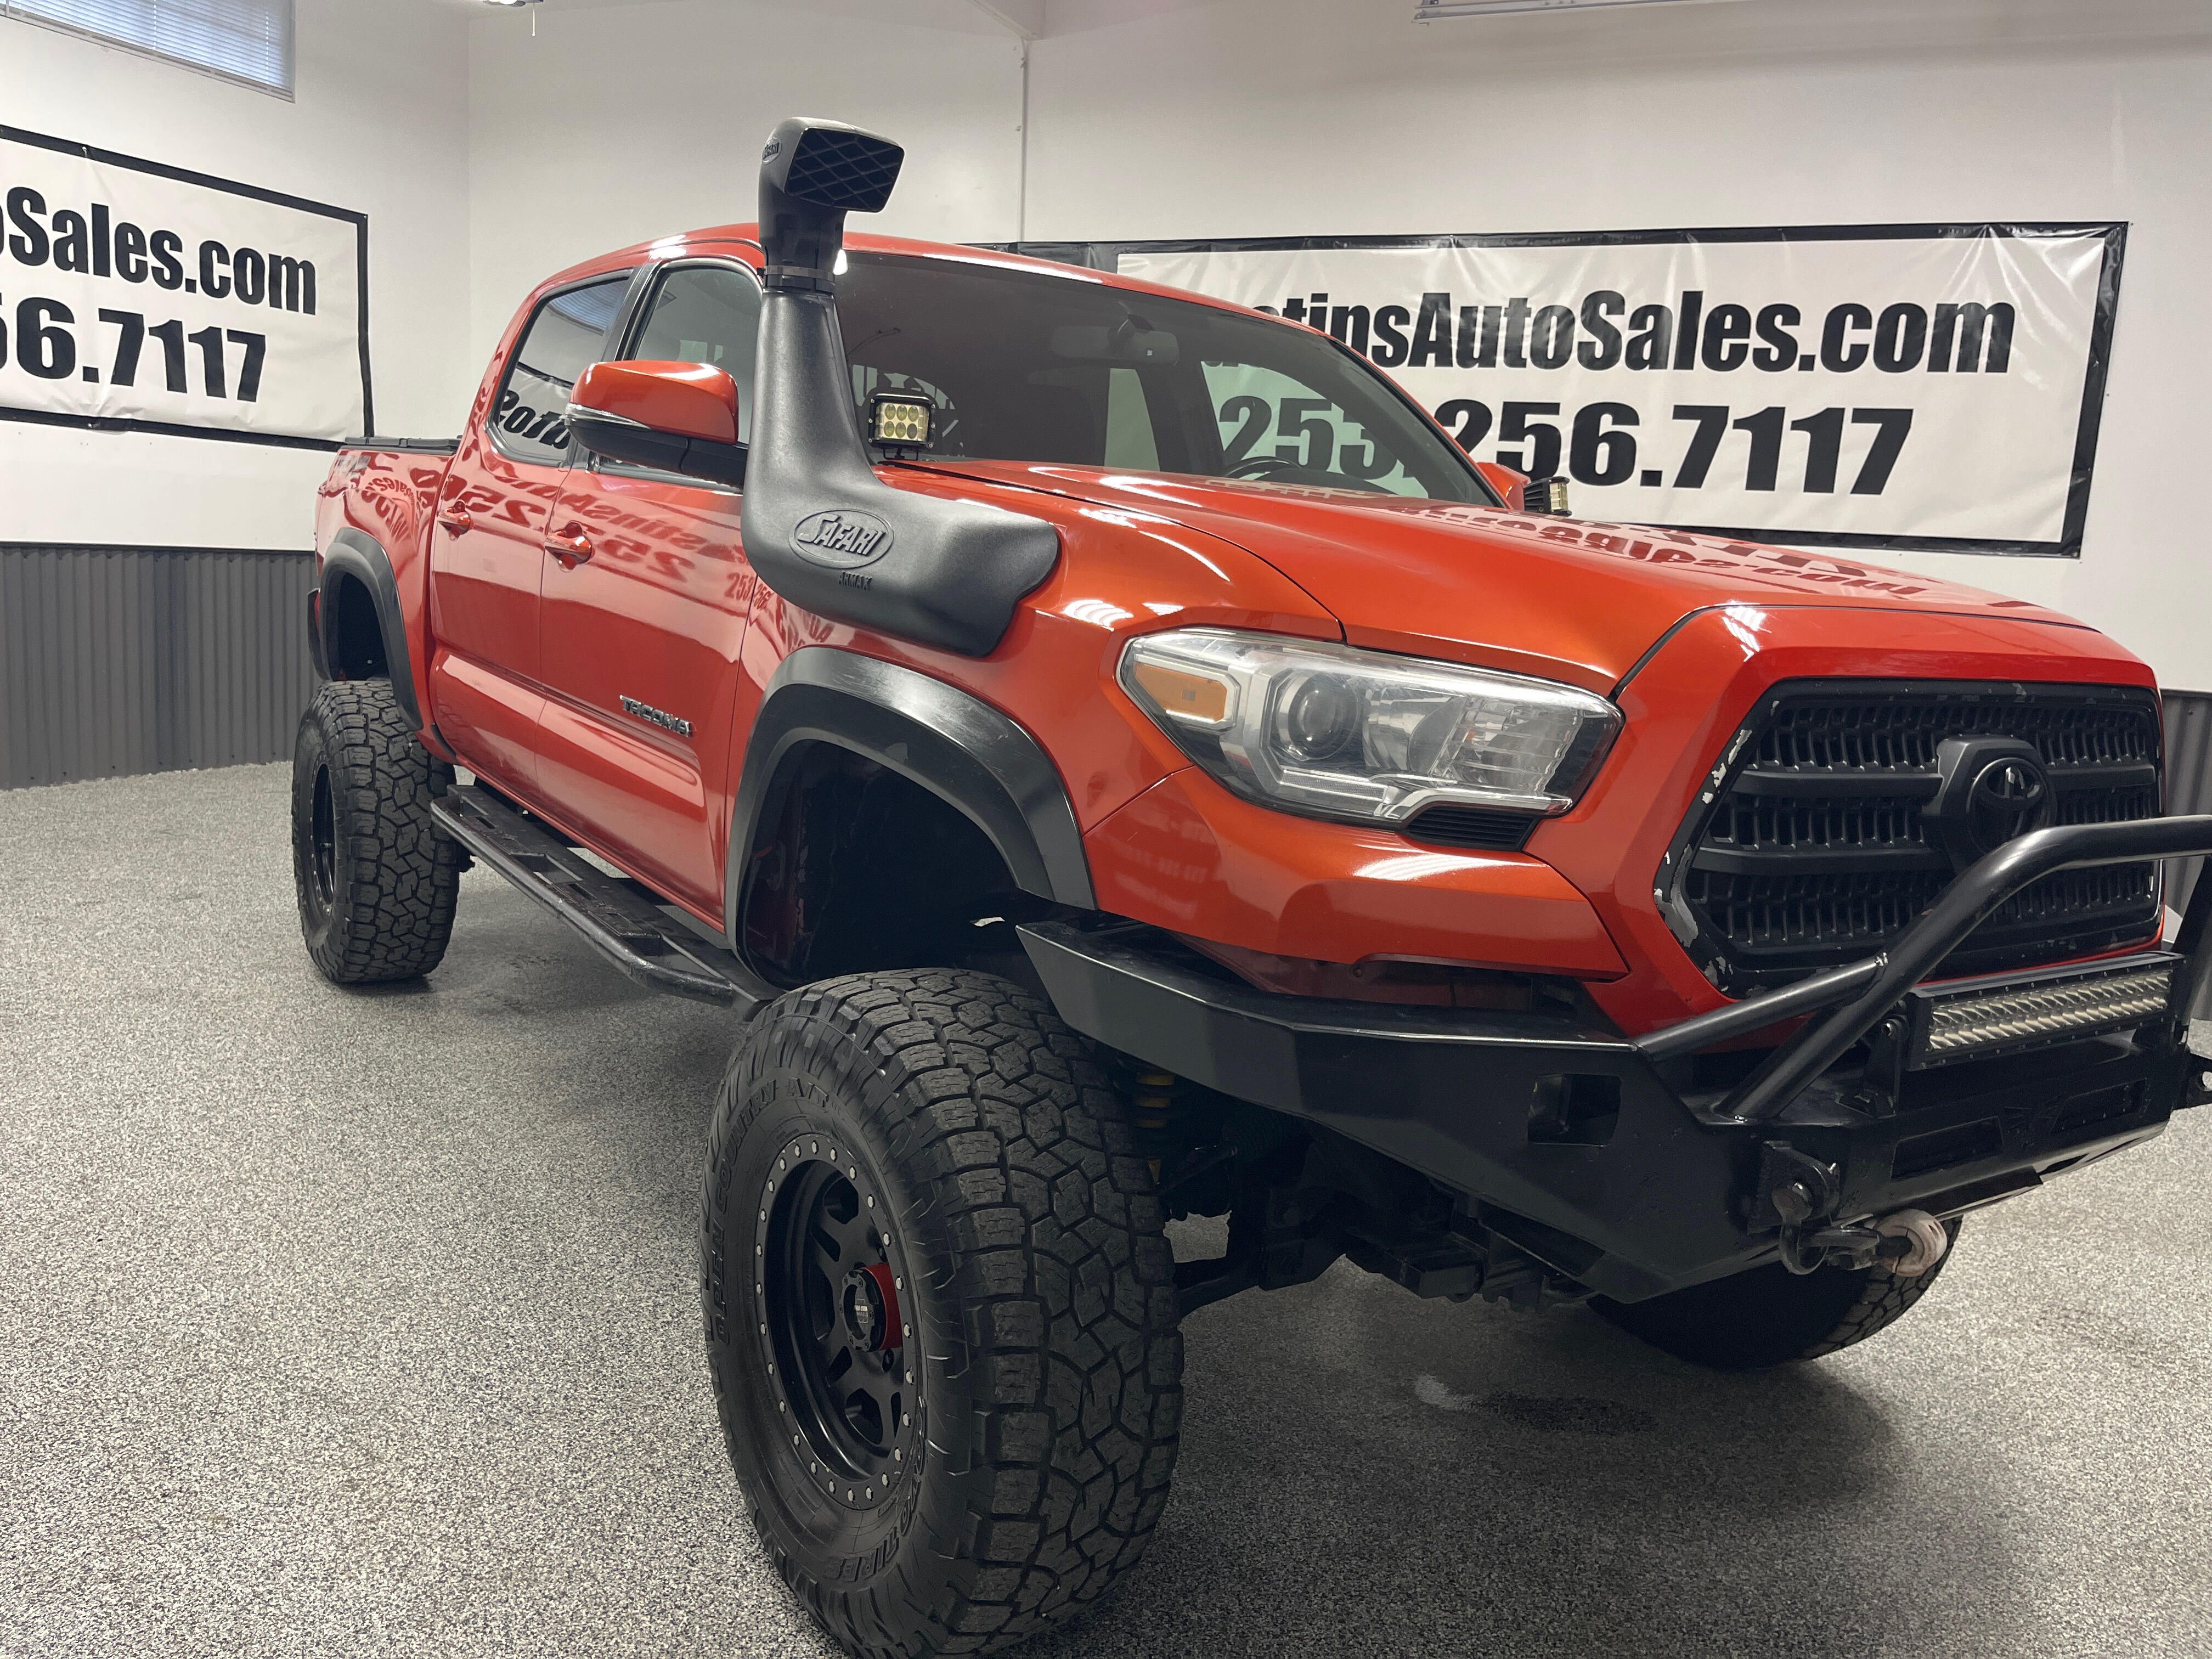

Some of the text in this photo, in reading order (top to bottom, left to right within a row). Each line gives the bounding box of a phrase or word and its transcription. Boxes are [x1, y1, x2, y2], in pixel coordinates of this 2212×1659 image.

[0, 187, 316, 316] Sales.com
[0, 292, 267, 403] 6.7117
[797, 513, 887, 556] SAFARI
[619, 695, 693, 737] TACOMA
[715, 1079, 777, 1215] COUNTRY
